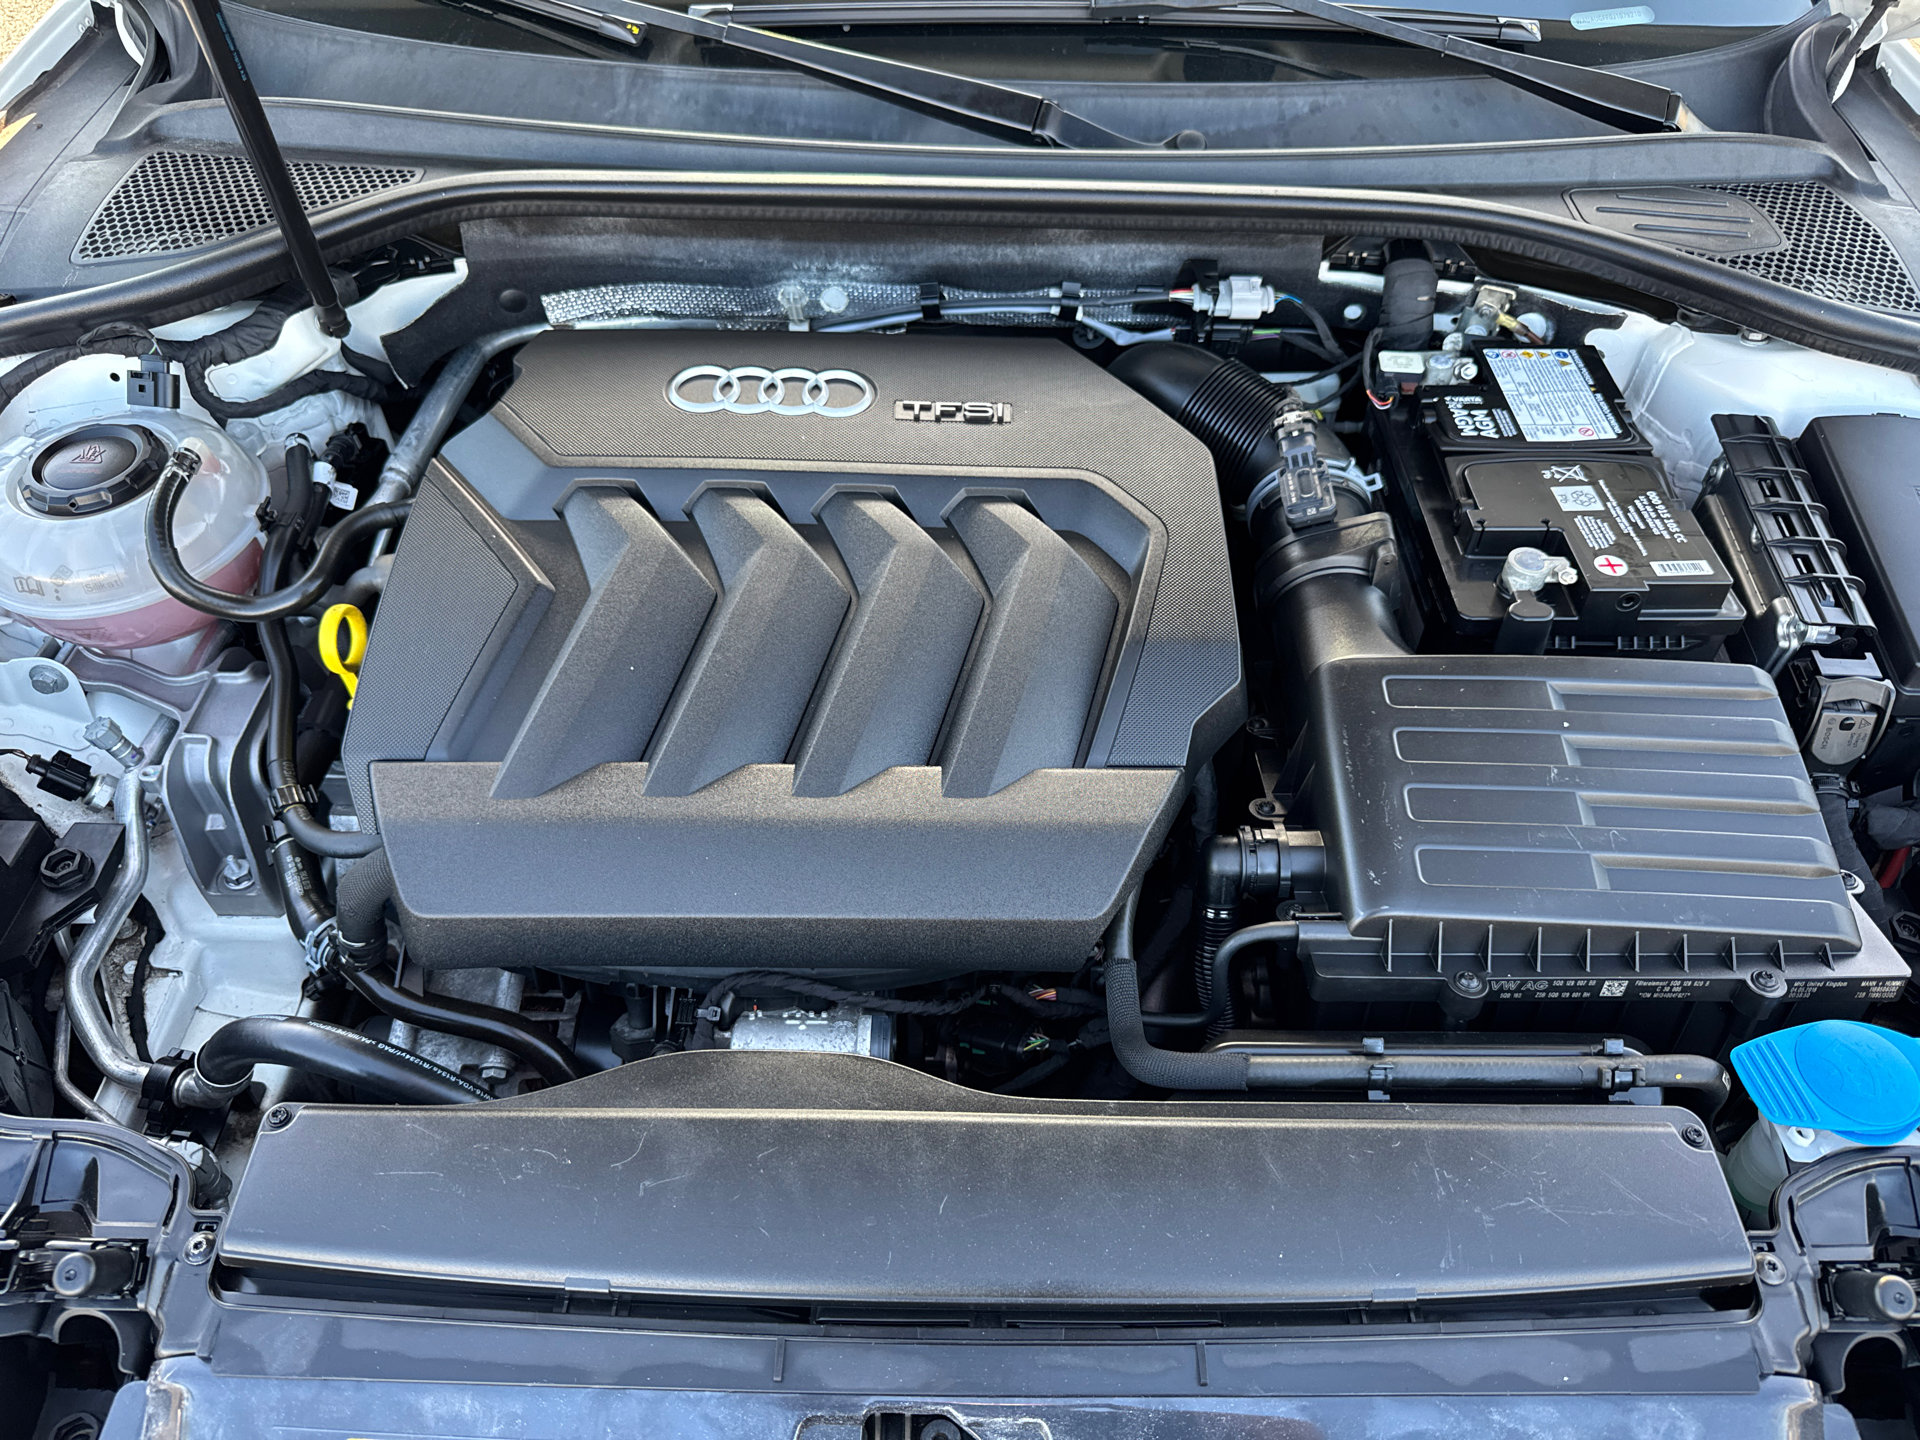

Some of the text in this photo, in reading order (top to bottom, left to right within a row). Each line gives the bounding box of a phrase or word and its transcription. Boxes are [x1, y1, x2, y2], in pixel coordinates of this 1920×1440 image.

[902, 400, 1004, 422] TFSI
[1450, 408, 1479, 436] AGM
[1470, 409, 1501, 439] AGM
[1646, 491, 1688, 543] 000 915 105 CC
[1820, 727, 1833, 750] BOSCH
[1490, 980, 1549, 991] VW AG
